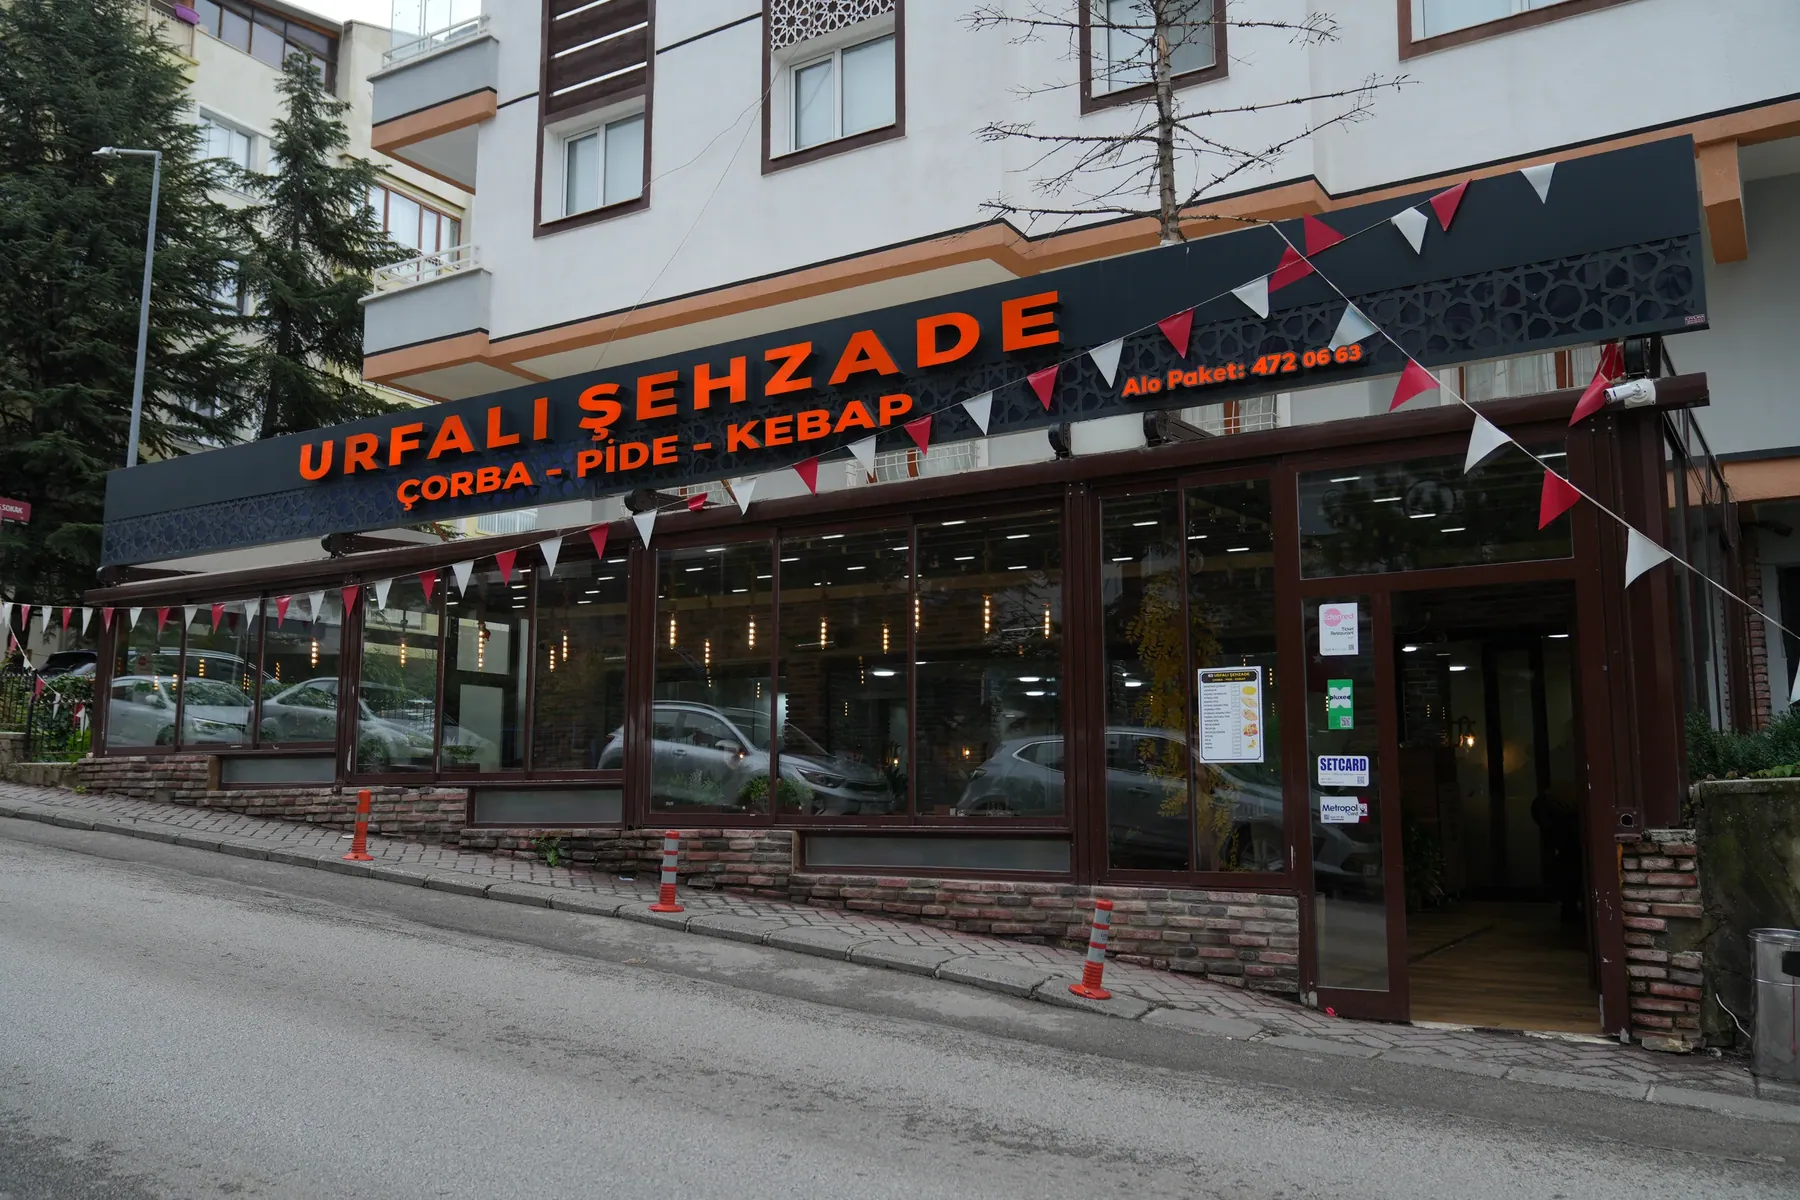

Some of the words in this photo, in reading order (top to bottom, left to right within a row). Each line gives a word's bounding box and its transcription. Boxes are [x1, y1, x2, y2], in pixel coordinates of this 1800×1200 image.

[300, 397, 548, 480] URFALI
[578, 289, 1060, 441] ŞEHZADE
[1122, 377, 1162, 397] Alo
[1168, 362, 1245, 389] Paket:
[1251, 352, 1297, 376] 472
[1303, 350, 1331, 368] 06
[1335, 344, 1362, 363] 63
[396, 461, 533, 511] ÇORBA
[576, 433, 679, 478] PİDE
[727, 393, 913, 453] KEBAP
[1320, 758, 1367, 771] SETCARD
[1322, 804, 1358, 813] Metropol
